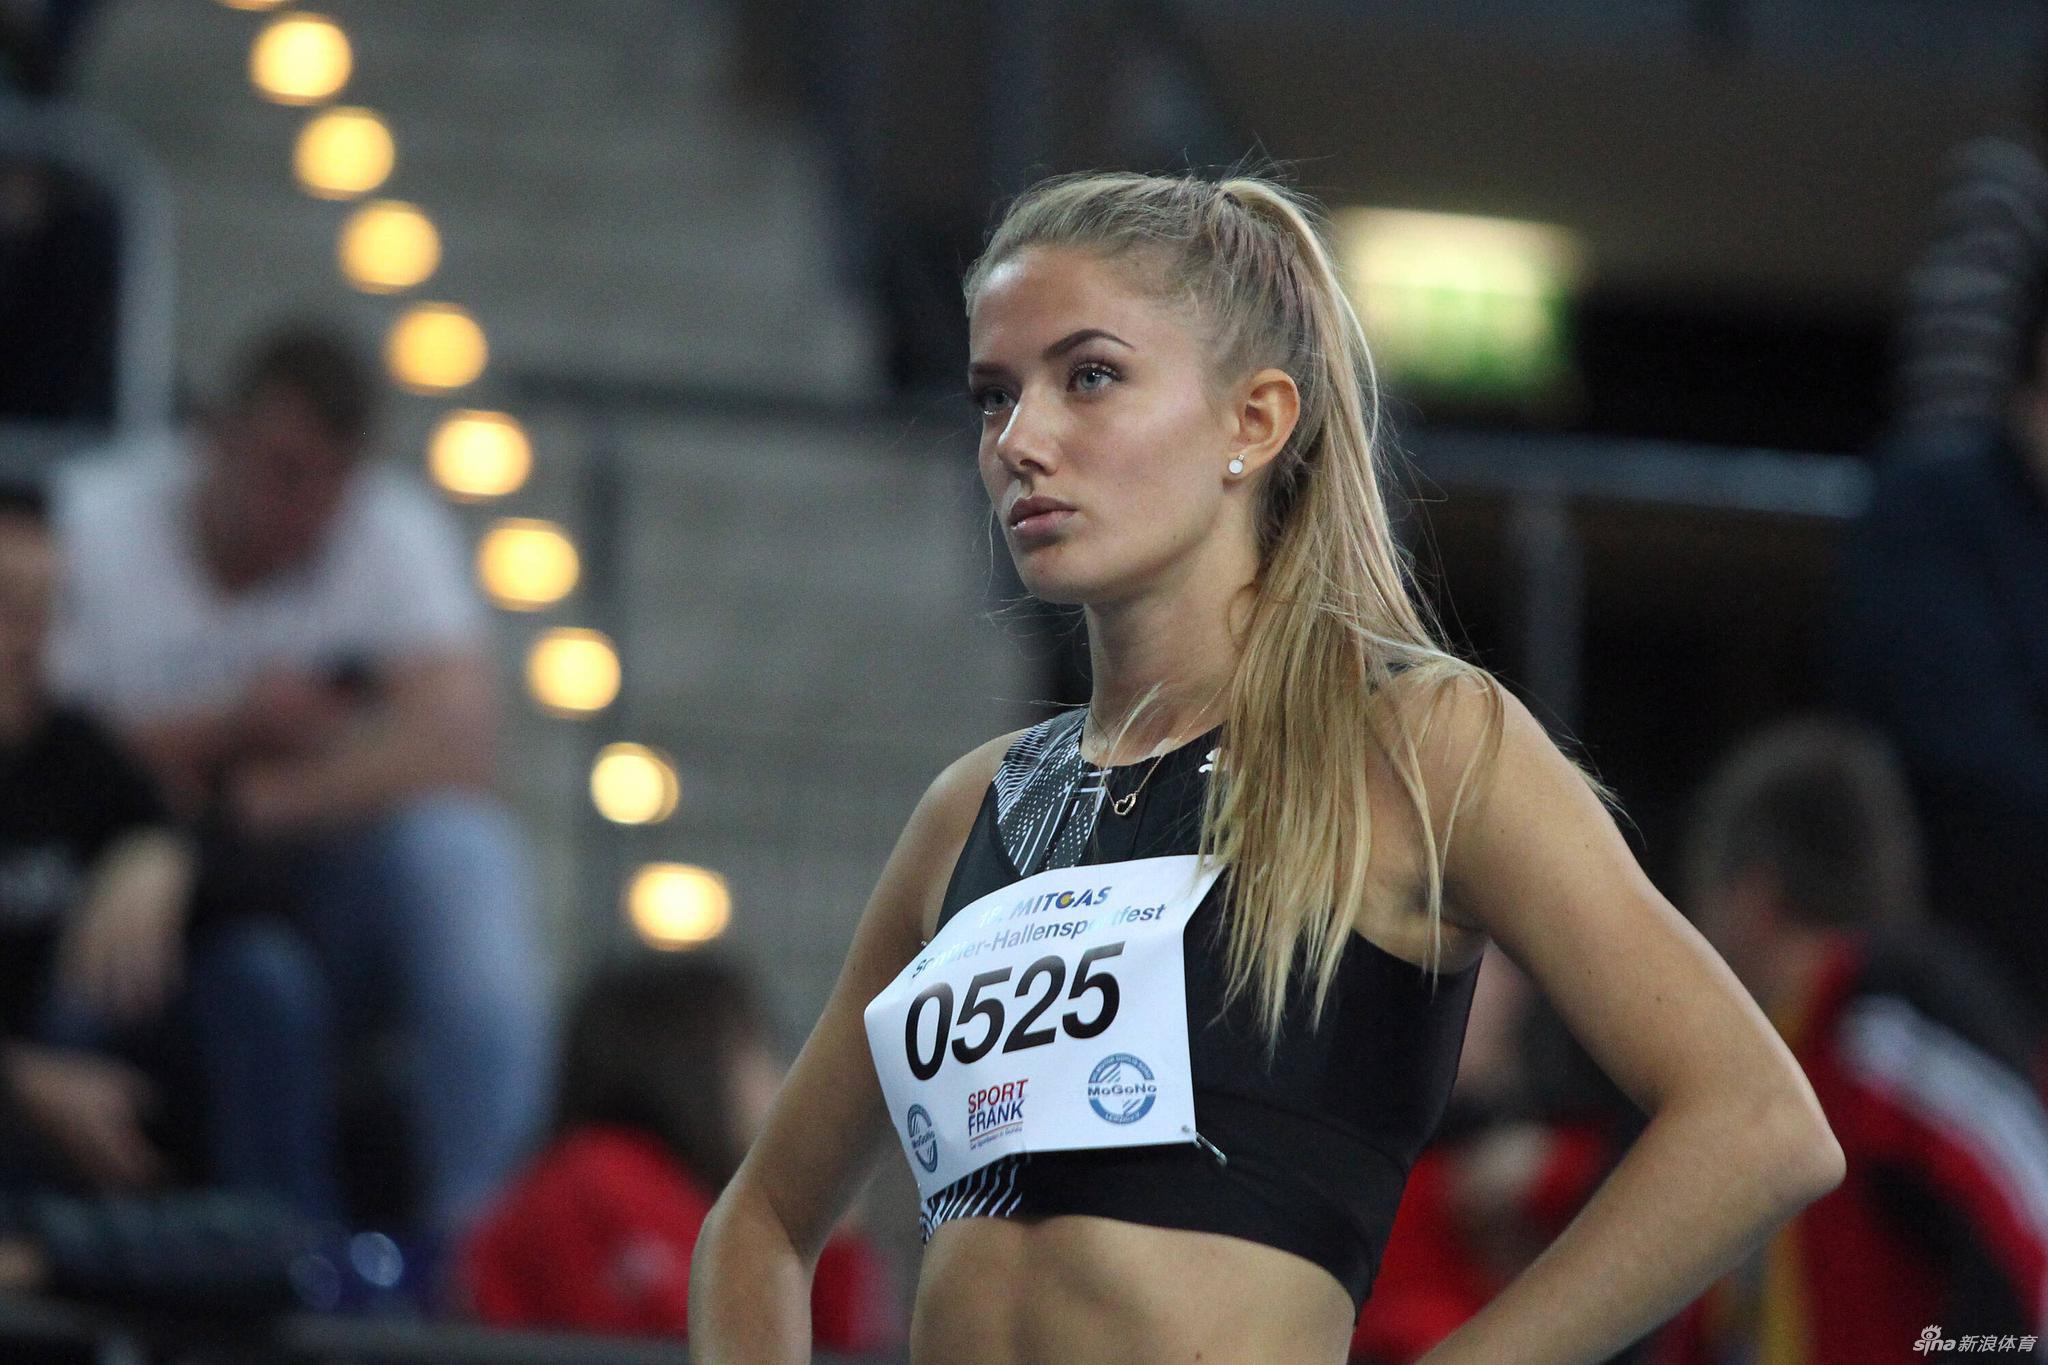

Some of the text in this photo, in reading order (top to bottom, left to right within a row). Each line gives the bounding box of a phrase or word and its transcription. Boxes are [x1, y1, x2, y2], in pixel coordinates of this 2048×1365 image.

[1010, 886, 1112, 919] MITGAS
[905, 941, 1126, 1080] 0525
[968, 1078, 1029, 1113] SPORT
[1087, 1083, 1157, 1096] MoGoNo
[967, 1100, 1024, 1136] FRANK
